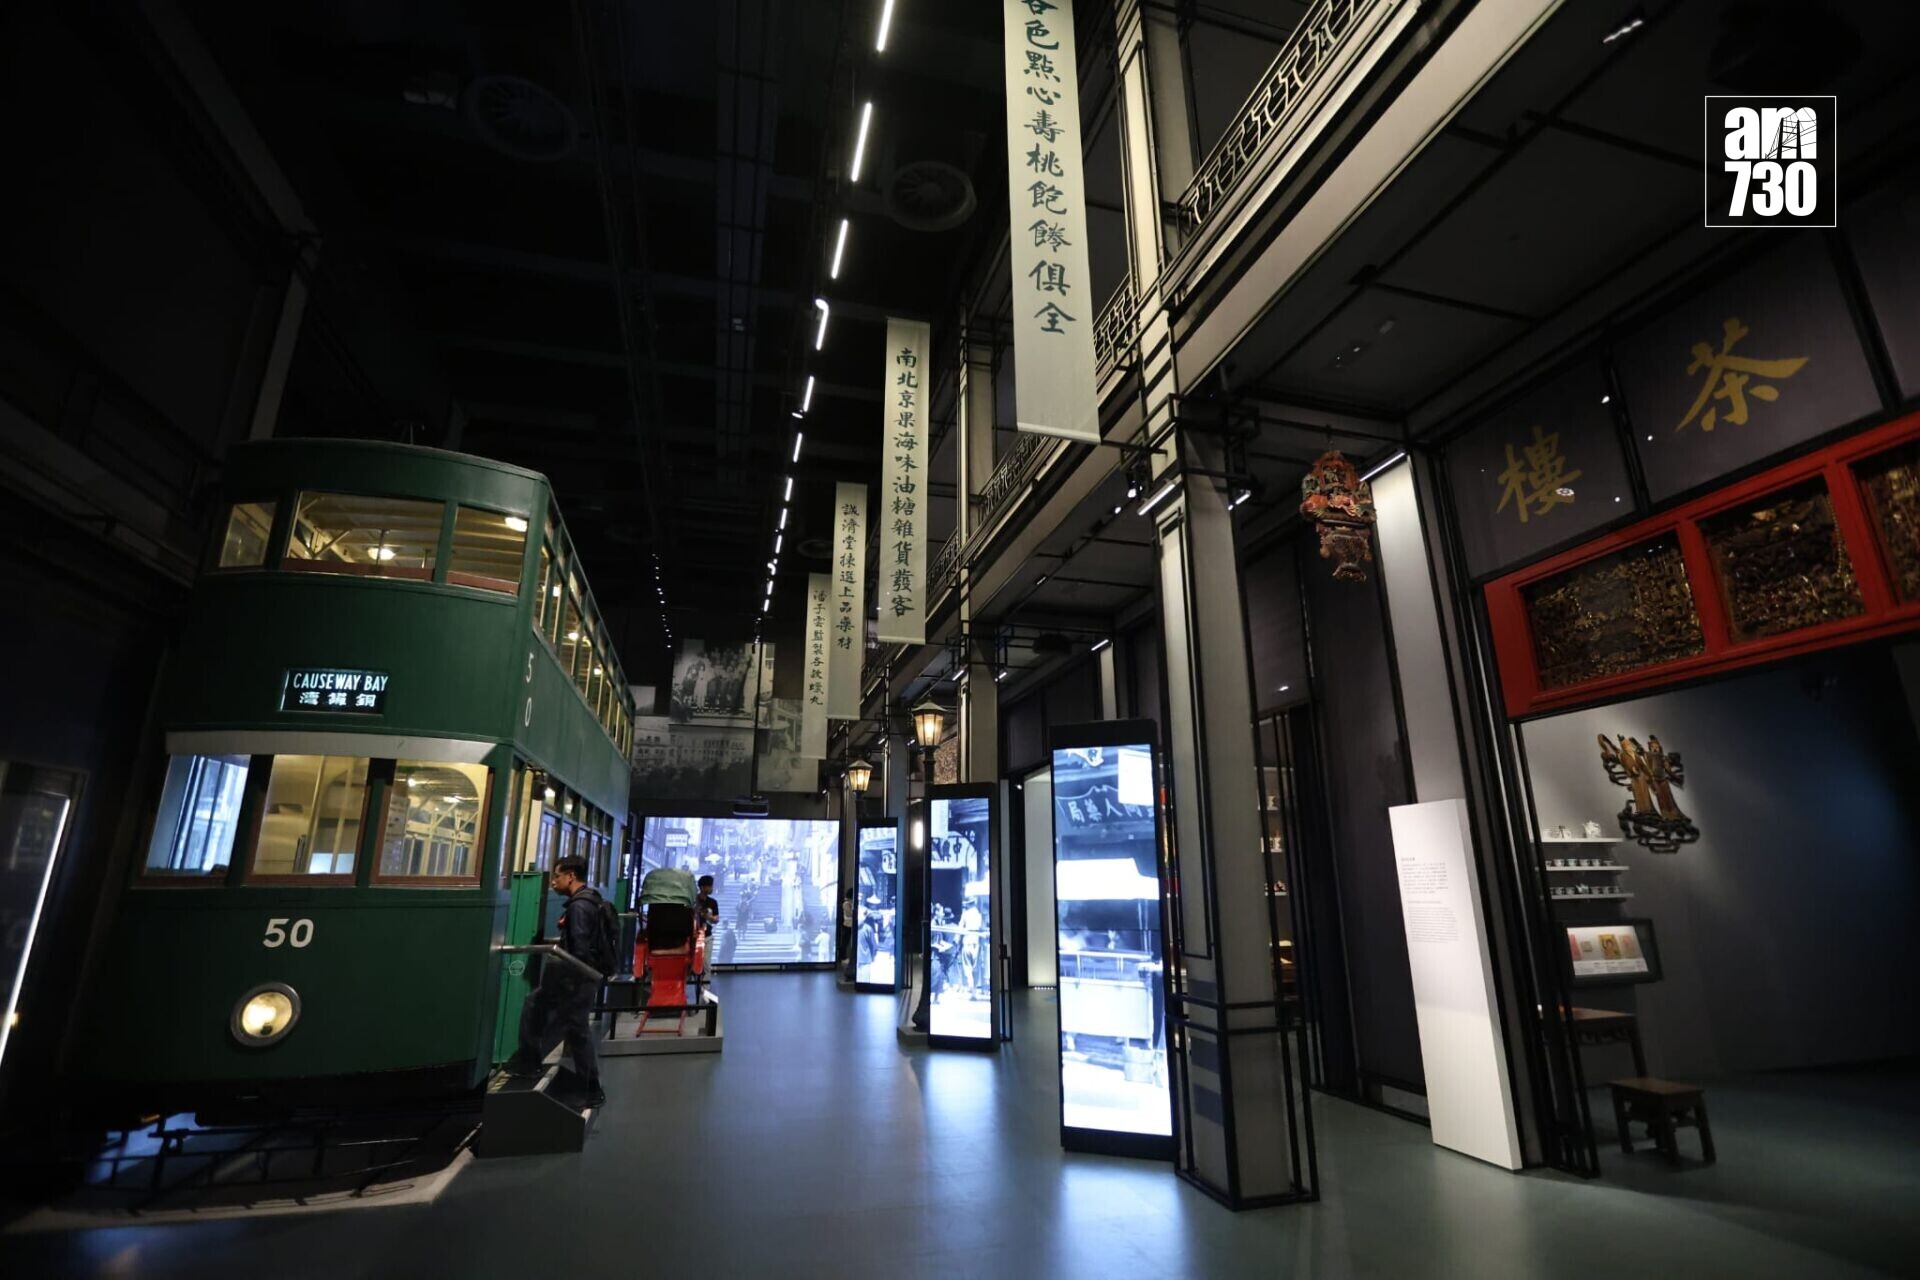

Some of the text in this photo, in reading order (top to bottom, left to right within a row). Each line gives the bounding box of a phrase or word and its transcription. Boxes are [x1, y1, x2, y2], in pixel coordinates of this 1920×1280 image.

[293, 673, 389, 691] CAUSEWAY BAY
[262, 918, 314, 948] 50
